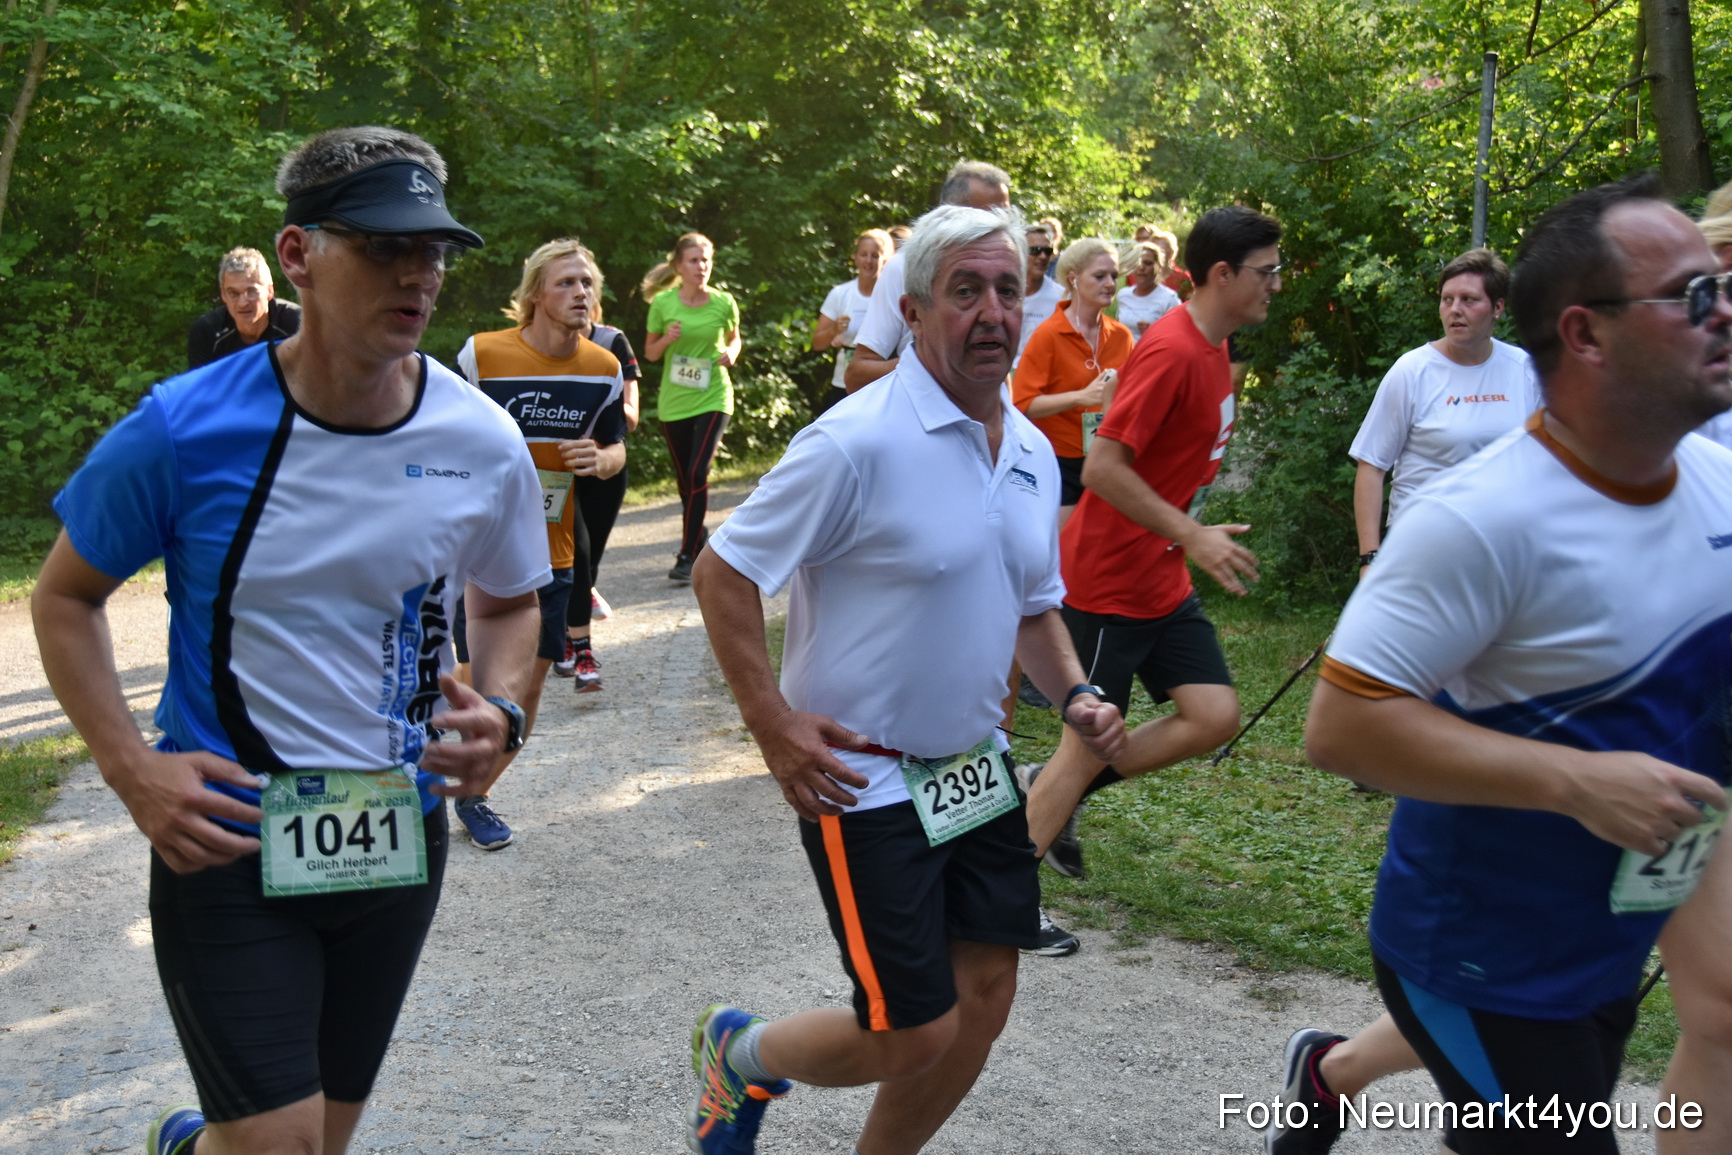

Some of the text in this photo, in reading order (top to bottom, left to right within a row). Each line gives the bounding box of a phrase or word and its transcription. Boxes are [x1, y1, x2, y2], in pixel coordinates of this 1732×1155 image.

[678, 367, 702, 381] 446
[1463, 394, 1510, 403] KLEBL
[520, 403, 587, 422] Fischer
[525, 419, 581, 429] AUTOMOBILE
[382, 619, 396, 669] WASTE
[923, 756, 999, 816] 2392
[945, 792, 995, 820] Vetter Thomas
[283, 808, 400, 858] 1041
[306, 854, 389, 871] Gilch Herbert
[325, 869, 371, 880] HUBER SE
